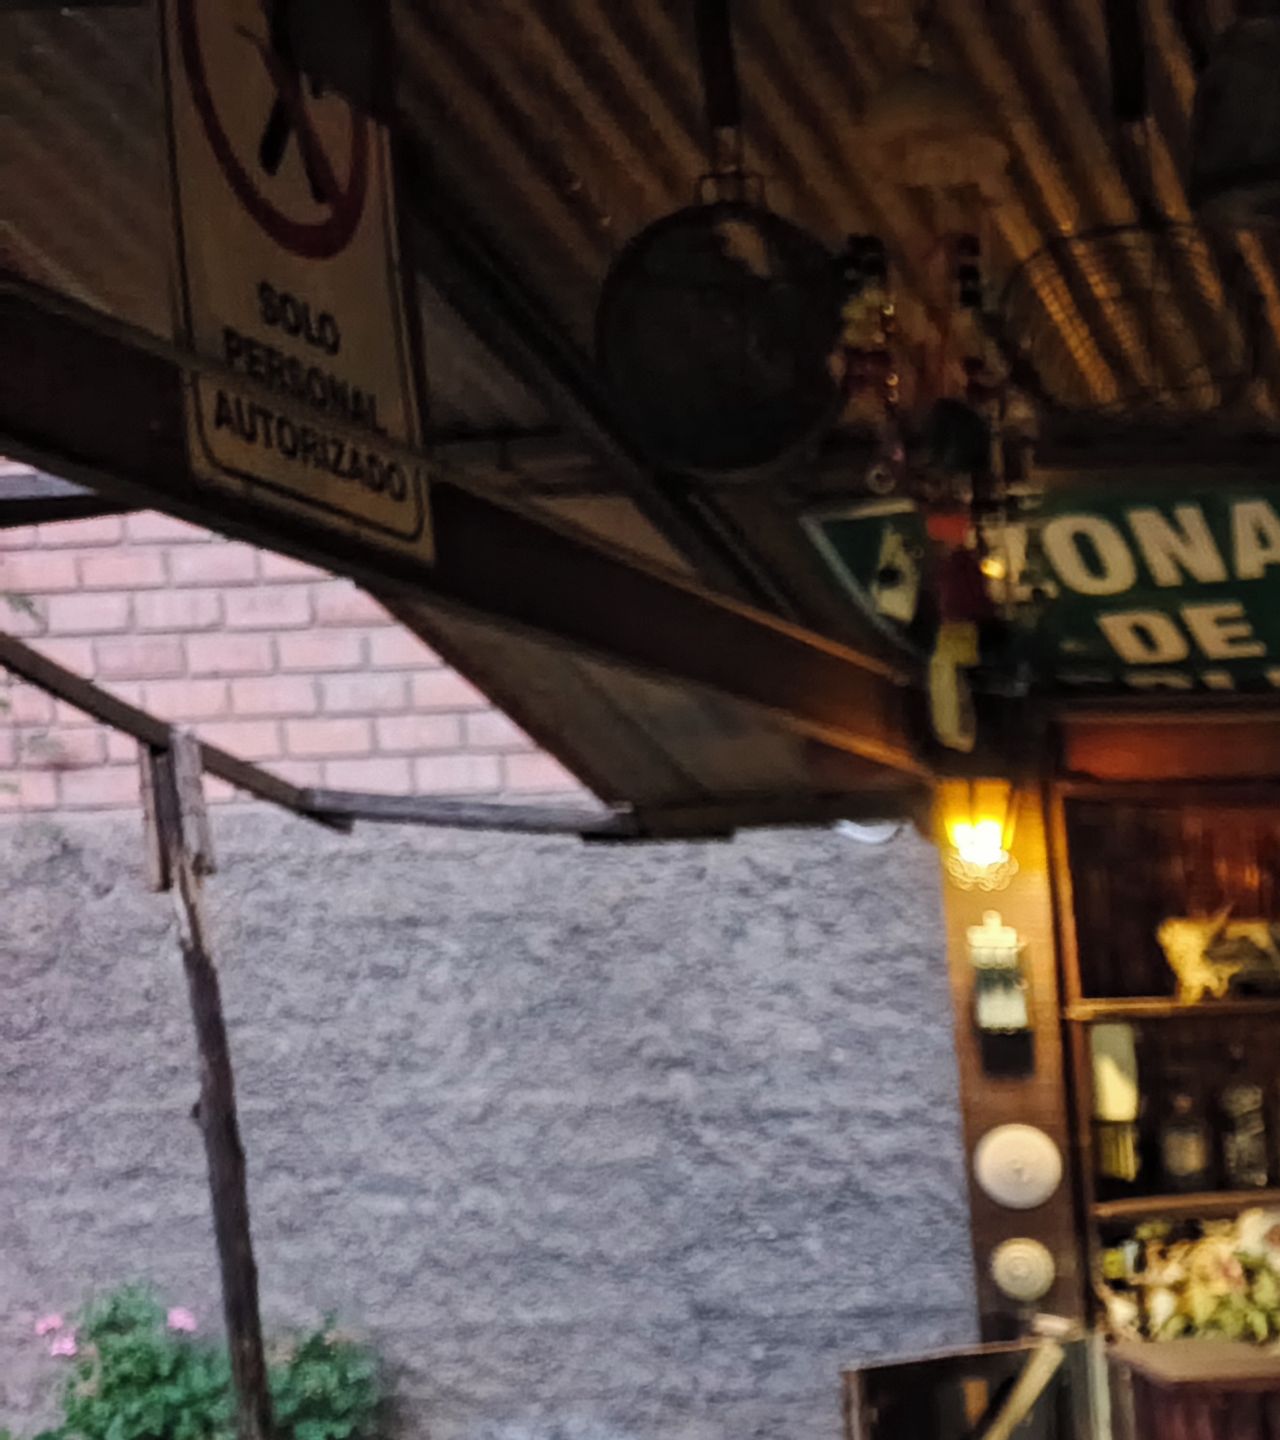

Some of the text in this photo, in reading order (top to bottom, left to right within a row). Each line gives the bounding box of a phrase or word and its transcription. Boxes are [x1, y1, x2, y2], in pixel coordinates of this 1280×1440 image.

[259, 281, 341, 355] SOLO
[224, 326, 388, 437] PERSONAL
[216, 389, 406, 502] AUTORIZADO
[1096, 598, 1269, 666] DE
